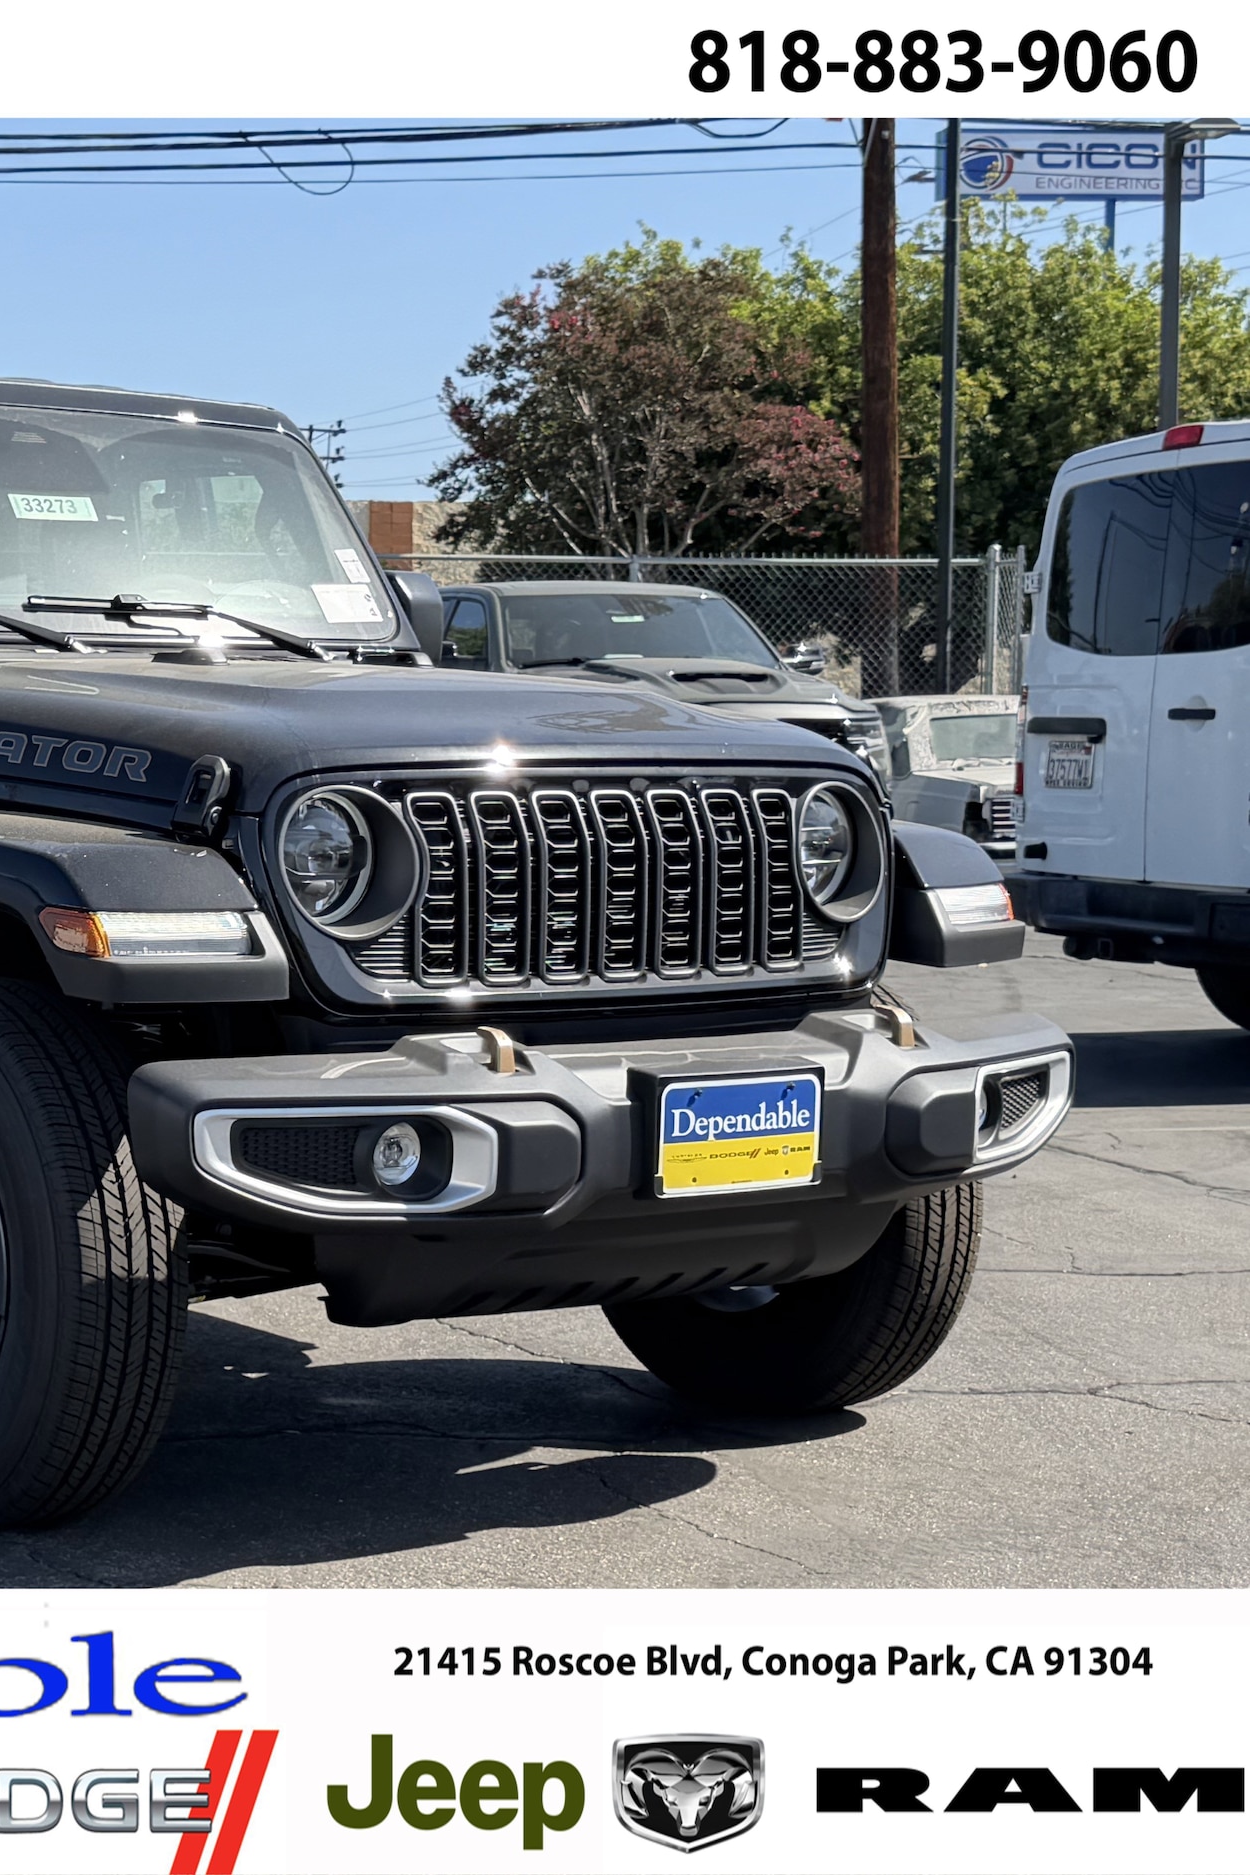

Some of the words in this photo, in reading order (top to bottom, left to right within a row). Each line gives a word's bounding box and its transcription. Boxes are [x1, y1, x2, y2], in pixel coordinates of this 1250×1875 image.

[1035, 177, 1161, 191] ENGINEERING
[20, 497, 78, 514] 33273
[671, 1099, 811, 1141] Dependable
[709, 1151, 753, 1159] DODGE
[764, 1147, 780, 1156] Jeep
